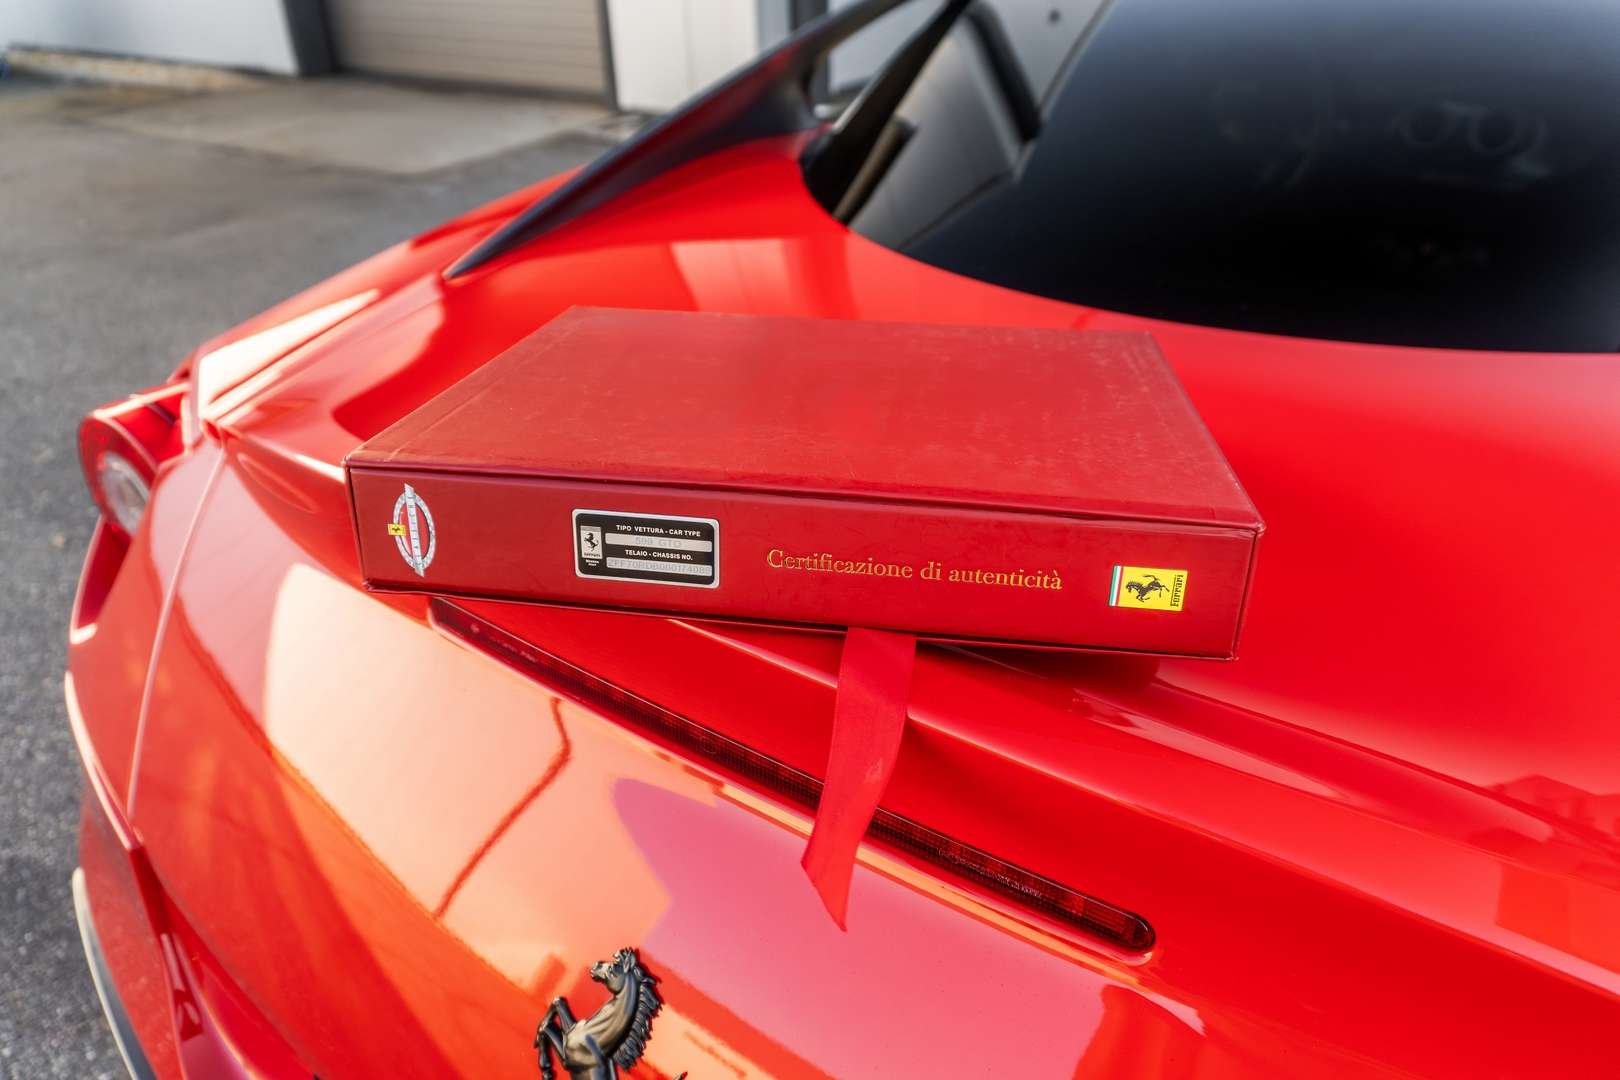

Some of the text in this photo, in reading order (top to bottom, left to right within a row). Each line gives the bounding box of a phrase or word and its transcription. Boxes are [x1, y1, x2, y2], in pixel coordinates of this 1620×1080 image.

[616, 524, 632, 532] TIPO
[634, 526, 664, 534] VETTURA
[625, 549, 648, 557] TELAIO
[652, 551, 681, 559] CHASSIS
[767, 549, 1063, 590] Certificazione di autenticità
[1170, 574, 1184, 607] Ferrari
